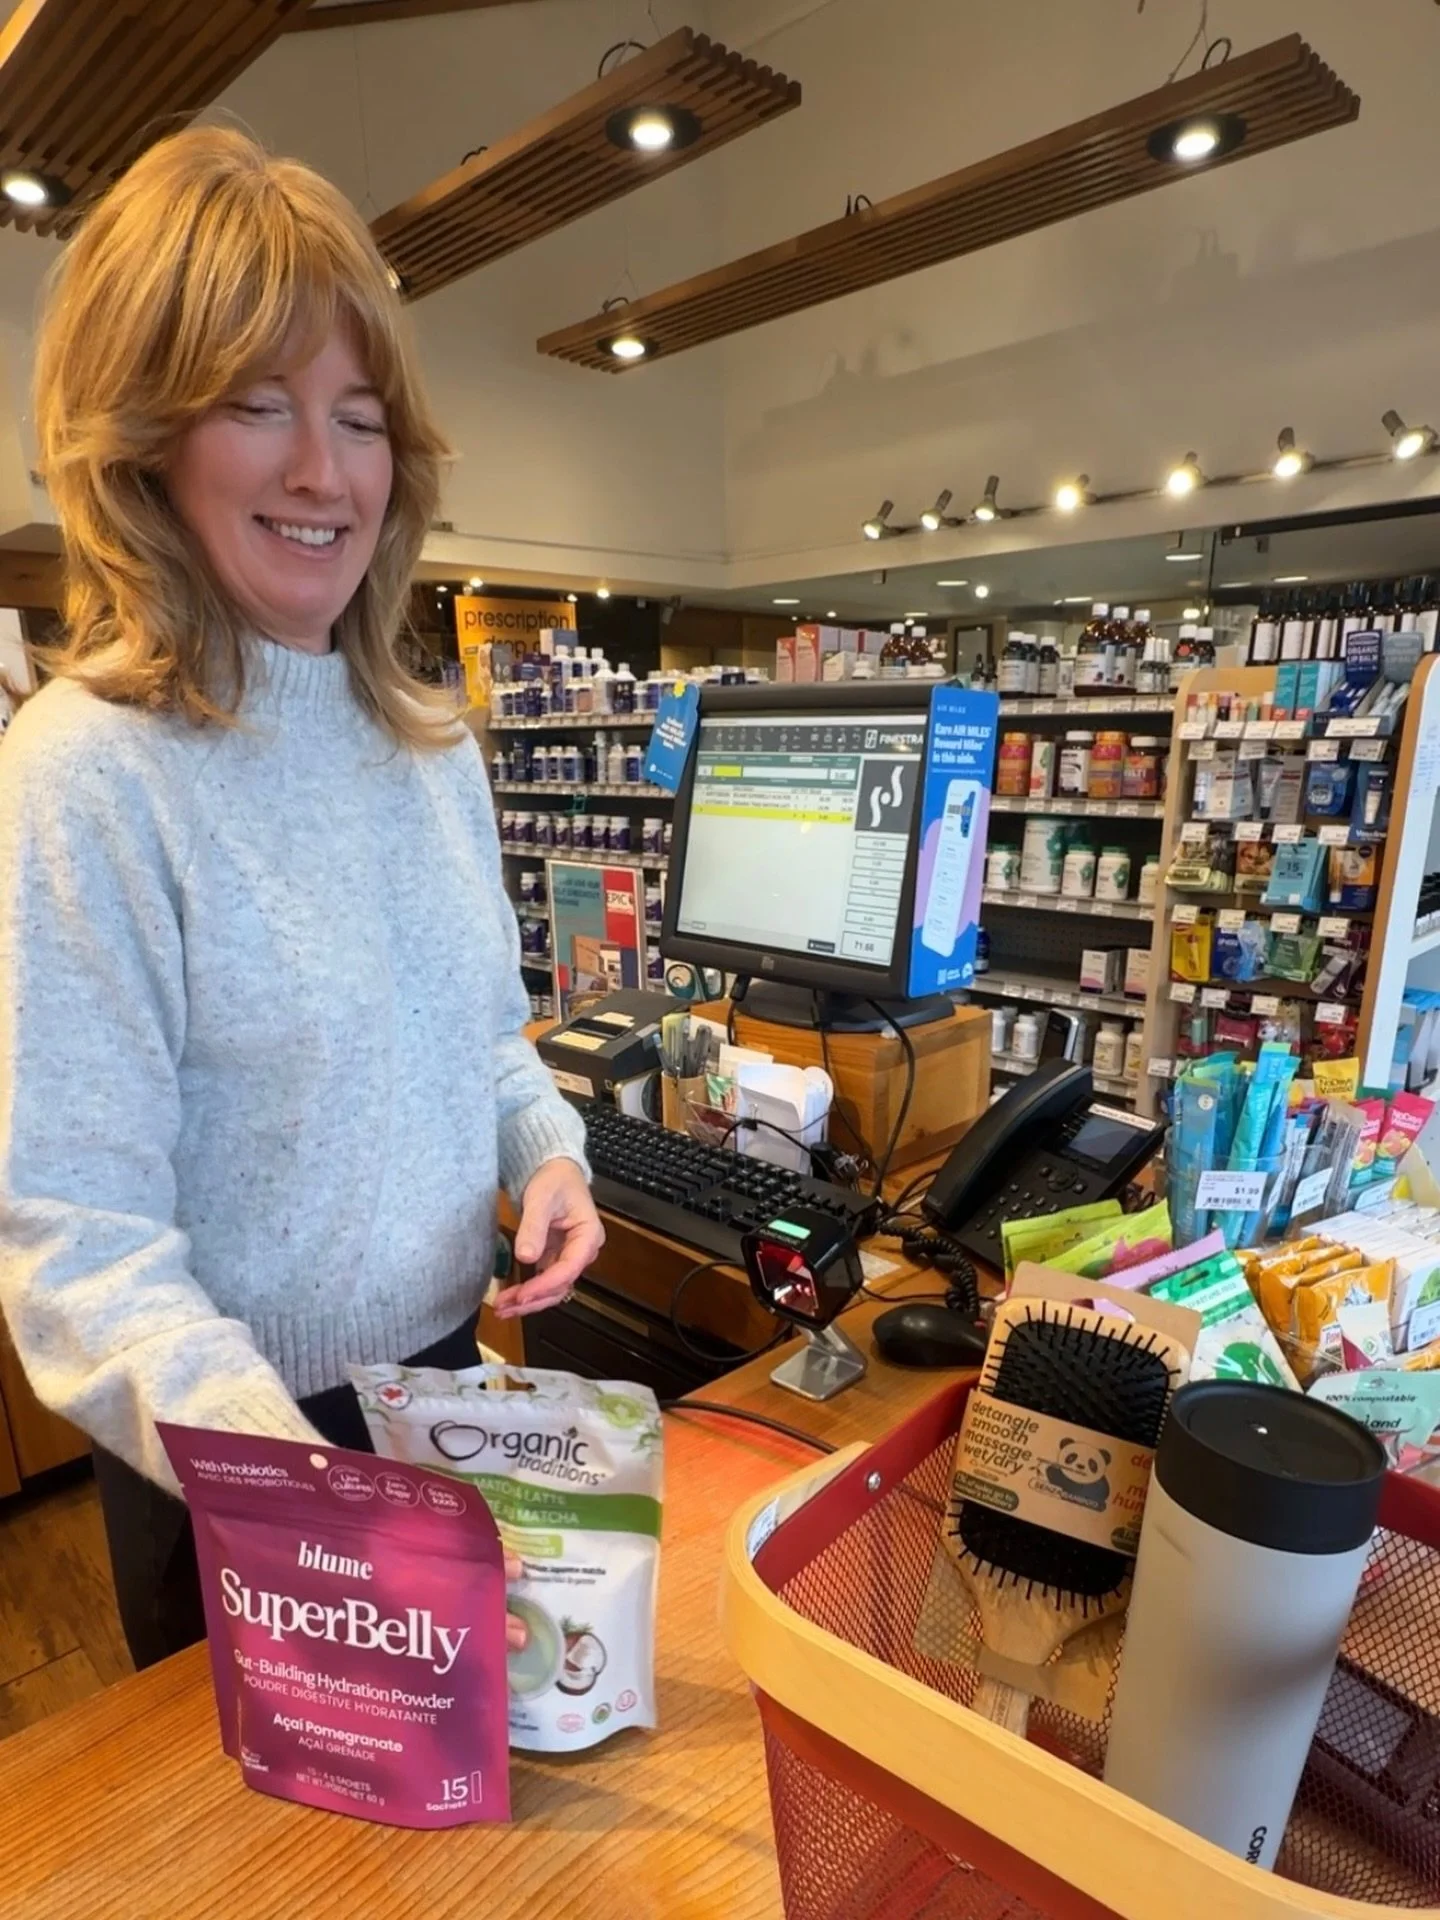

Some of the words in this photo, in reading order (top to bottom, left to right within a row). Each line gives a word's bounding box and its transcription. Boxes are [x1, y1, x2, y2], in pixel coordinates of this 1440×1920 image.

[464, 608, 570, 633] prescription
[1352, 1394, 1417, 1404] compostable
[972, 1399, 1040, 1434] detangle
[1359, 1414, 1402, 1429] land
[429, 1420, 589, 1467] Organic
[971, 1416, 1029, 1446] smooth
[965, 1428, 1033, 1462] massage
[190, 1458, 222, 1474] With
[222, 1461, 289, 1479] Probiotics
[517, 1454, 600, 1487] traditions
[963, 1441, 1024, 1475] wet/dry
[198, 1471, 223, 1484] AVEC
[224, 1474, 242, 1485] DES
[243, 1476, 316, 1493] PROBIOTIQUES
[339, 1473, 361, 1484] Live
[517, 1508, 580, 1524] MATCHA
[298, 1540, 374, 1580] blume
[220, 1567, 471, 1676] SuperBelly
[234, 1648, 316, 1690] Gut-Building
[317, 1671, 390, 1703] Hydration
[390, 1688, 456, 1711] Powder
[243, 1673, 289, 1696] POUDRE
[291, 1685, 352, 1711] DIGESTIVE
[354, 1700, 438, 1725] HYDRATANTE
[304, 1719, 404, 1753] Pomegranate
[325, 1741, 377, 1763] GRENADE
[296, 1772, 311, 1785] NET
[336, 1775, 372, 1793] SACHETS
[440, 1776, 469, 1801] 15
[425, 1800, 468, 1812] Sachets
